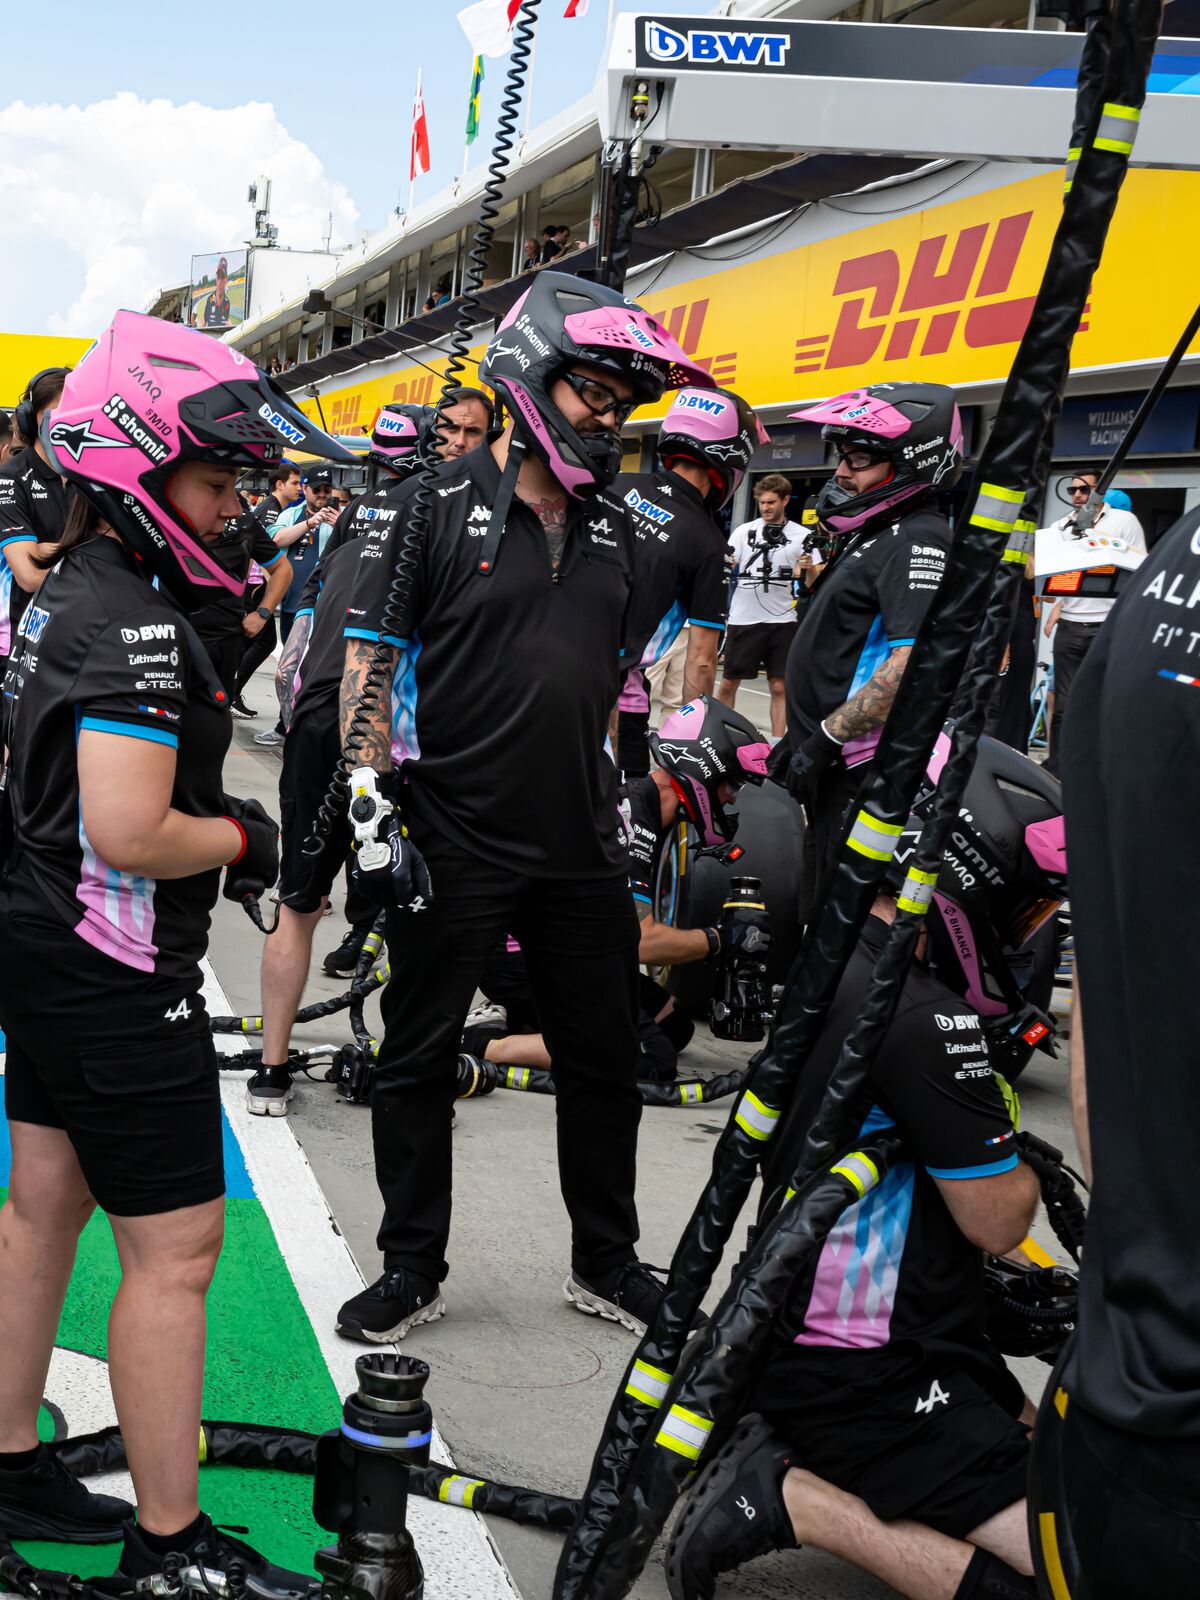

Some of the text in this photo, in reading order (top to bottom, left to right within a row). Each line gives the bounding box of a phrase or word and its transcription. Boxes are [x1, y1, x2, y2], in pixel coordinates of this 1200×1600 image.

[689, 32, 789, 65] BWT
[824, 211, 1036, 370] DHL
[522, 326, 550, 357] shamir
[631, 329, 655, 349] BWT
[519, 394, 541, 430] BINANCE
[687, 396, 726, 415] BWT
[847, 406, 869, 418] BWT
[269, 411, 306, 444] BWT
[380, 417, 406, 434] BWT
[1088, 409, 1135, 427] WILLIAMS
[119, 413, 168, 461] shamir
[914, 436, 945, 454] shamir
[1090, 429, 1127, 446] RACING
[636, 499, 674, 525] BWT
[132, 505, 167, 549] BINANCE
[922, 547, 946, 559] BWT
[139, 624, 176, 642] BWT
[129, 652, 169, 666] ultimate
[135, 680, 182, 690] E-TECH
[144, 672, 175, 680] RENAULT
[706, 746, 726, 774] shamir
[952, 831, 1005, 886] amir
[950, 917, 972, 960] BINANCE
